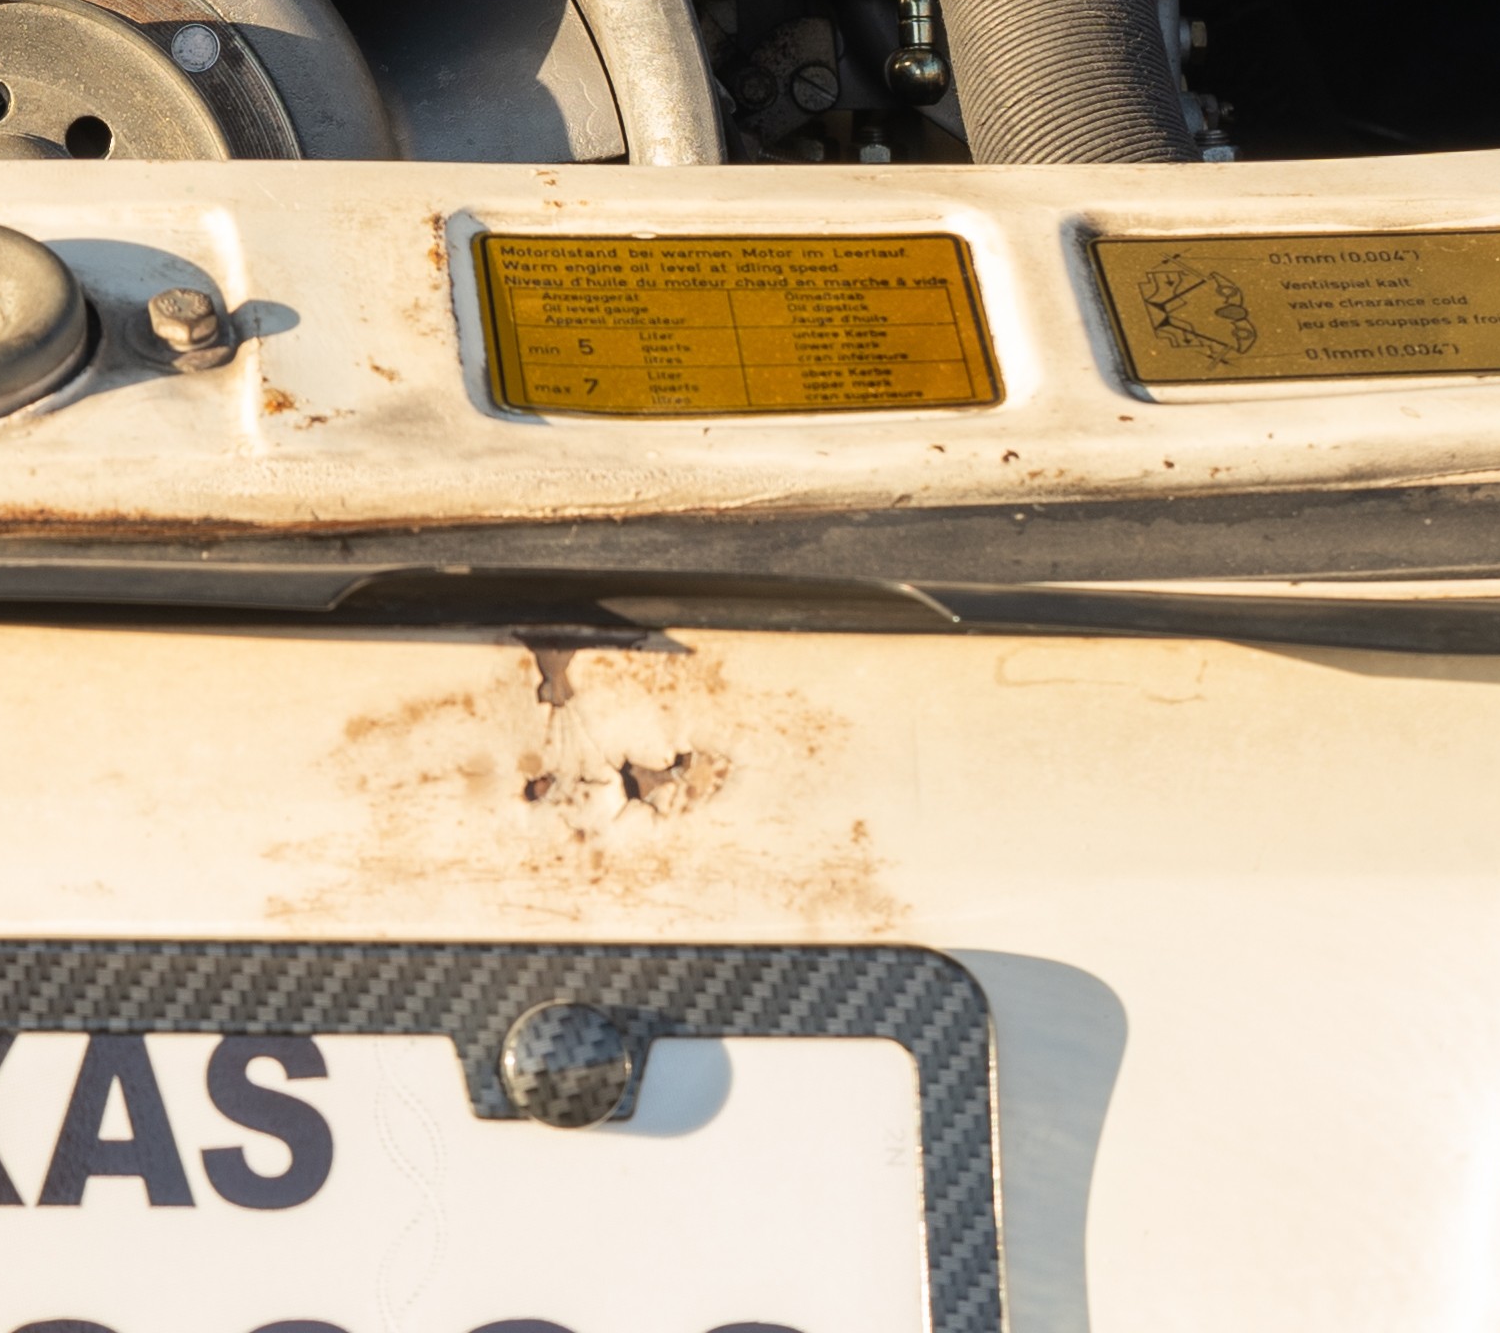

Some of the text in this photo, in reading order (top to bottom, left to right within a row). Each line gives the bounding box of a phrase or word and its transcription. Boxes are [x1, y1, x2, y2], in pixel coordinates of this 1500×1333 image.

[629, 248, 654, 259] bei
[660, 249, 732, 259] warmen
[742, 248, 792, 259] Motor
[801, 248, 824, 259] im
[502, 260, 558, 273] Warm
[565, 263, 624, 275] engine
[630, 262, 650, 273] oil
[660, 262, 702, 273] level
[710, 263, 727, 273] at
[736, 263, 784, 275] idling
[504, 275, 564, 287] Niveau
[637, 277, 656, 287] du
[664, 277, 726, 288] moteur
[735, 277, 789, 289] chaud
[798, 279, 817, 288] en
[823, 277, 890, 287] marche
[1280, 277, 1411, 291] Ventilspiel kalt
[542, 304, 649, 315] Oil level gauge
[787, 303, 869, 313] Oil dipstick
[1288, 295, 1468, 311] valve clearance cold
[545, 315, 686, 326] Appareil indicateur
[1297, 320, 1325, 331] jeu
[1329, 317, 1361, 329] des
[1364, 316, 1452, 329] soupapes
[639, 332, 674, 340] Liter
[528, 338, 595, 356] min 5
[647, 371, 683, 380] Liter
[534, 378, 600, 395] max 7
